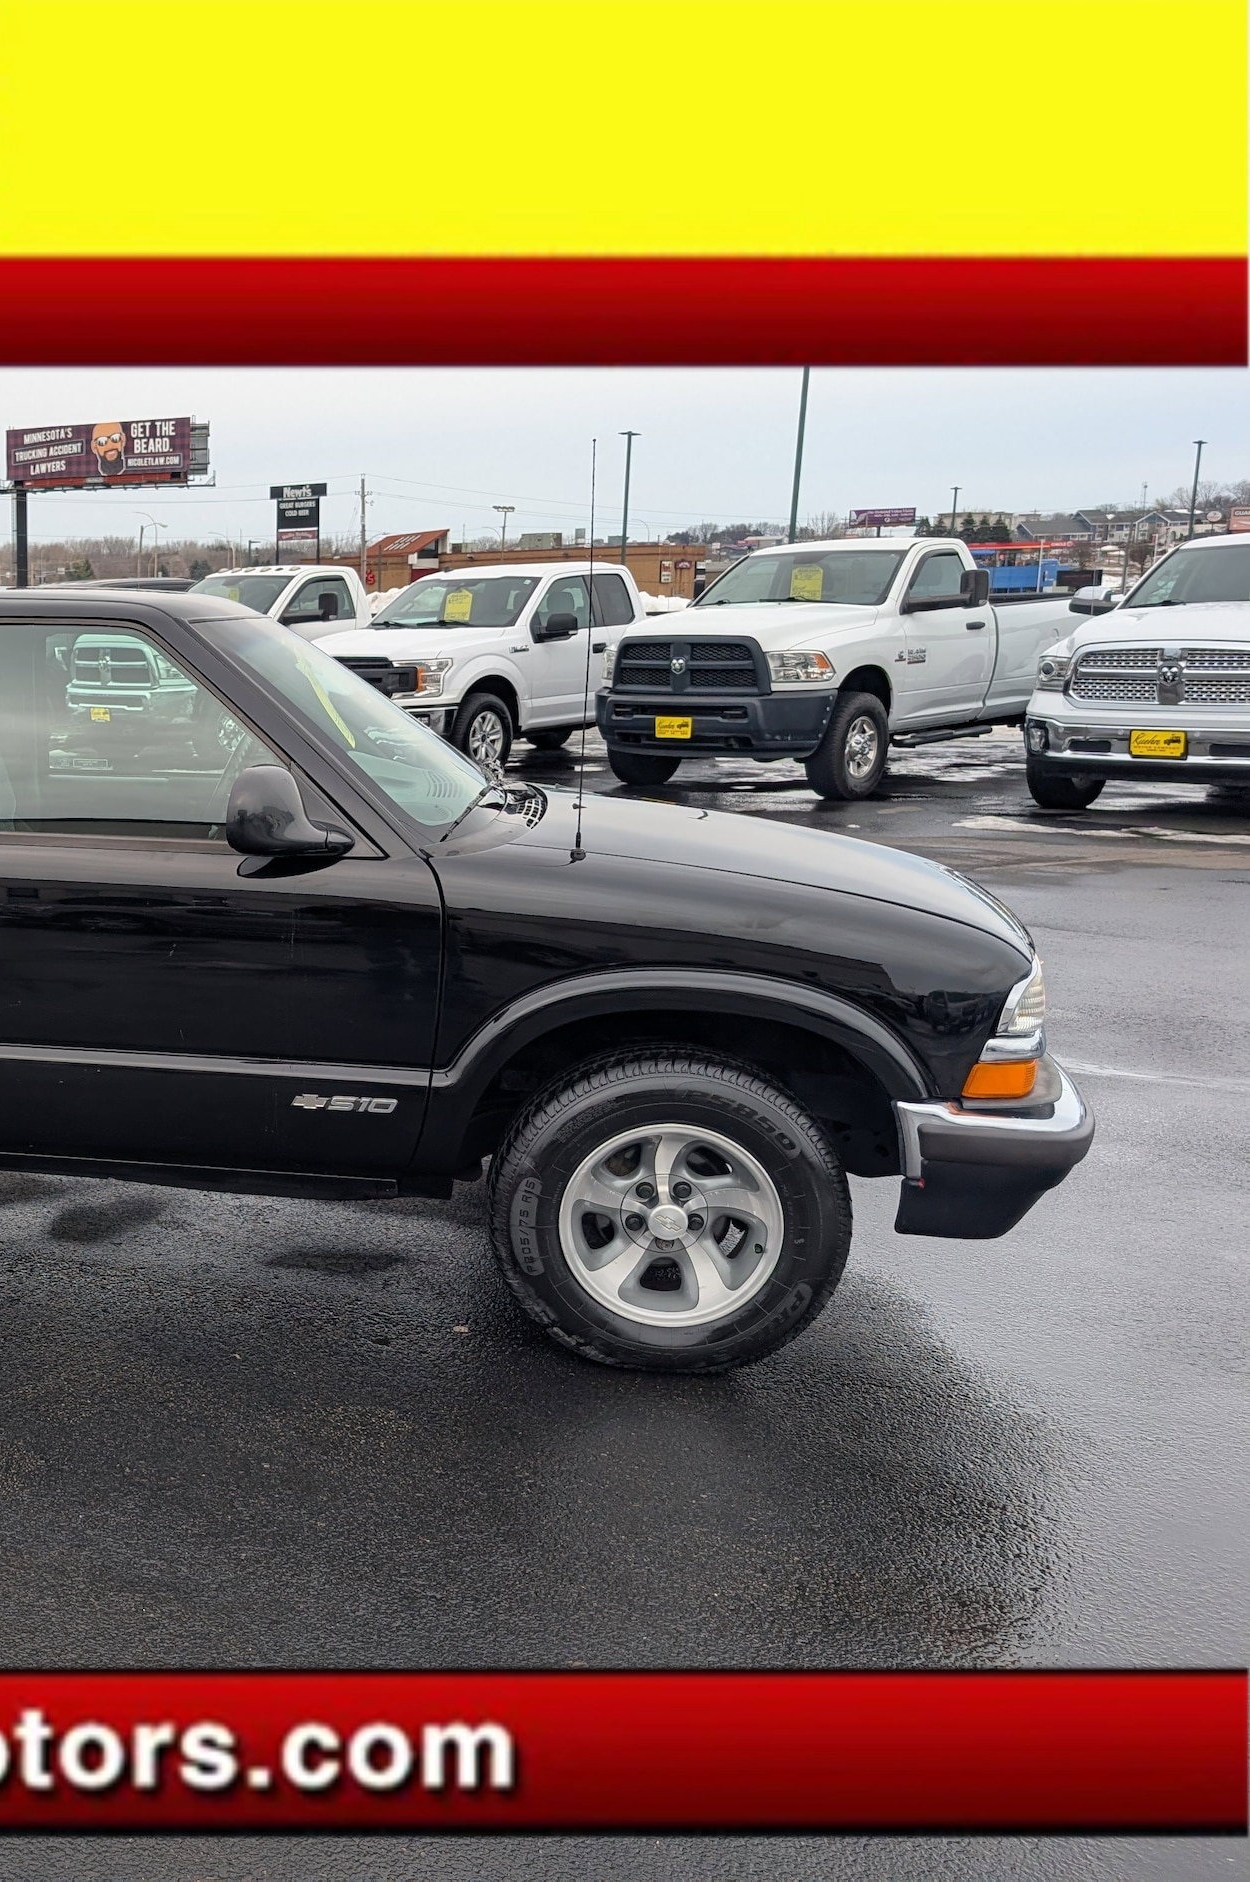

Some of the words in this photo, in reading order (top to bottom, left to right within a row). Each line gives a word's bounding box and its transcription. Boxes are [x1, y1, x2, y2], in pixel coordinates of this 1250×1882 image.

[23, 428, 73, 445] MINNESOTA'S
[130, 422, 152, 438] GET
[155, 421, 176, 436] THE
[15, 446, 47, 462] TRUCKING
[48, 442, 82, 457] ACCIDENT
[133, 438, 173, 454] BEARD.
[30, 460, 66, 475] LAWYERS
[127, 457, 180, 467] NICOLETLAW.COM
[283, 485, 312, 498] Newt's
[1132, 732, 1161, 745] Kuehn
[327, 1095, 398, 1114] S10
